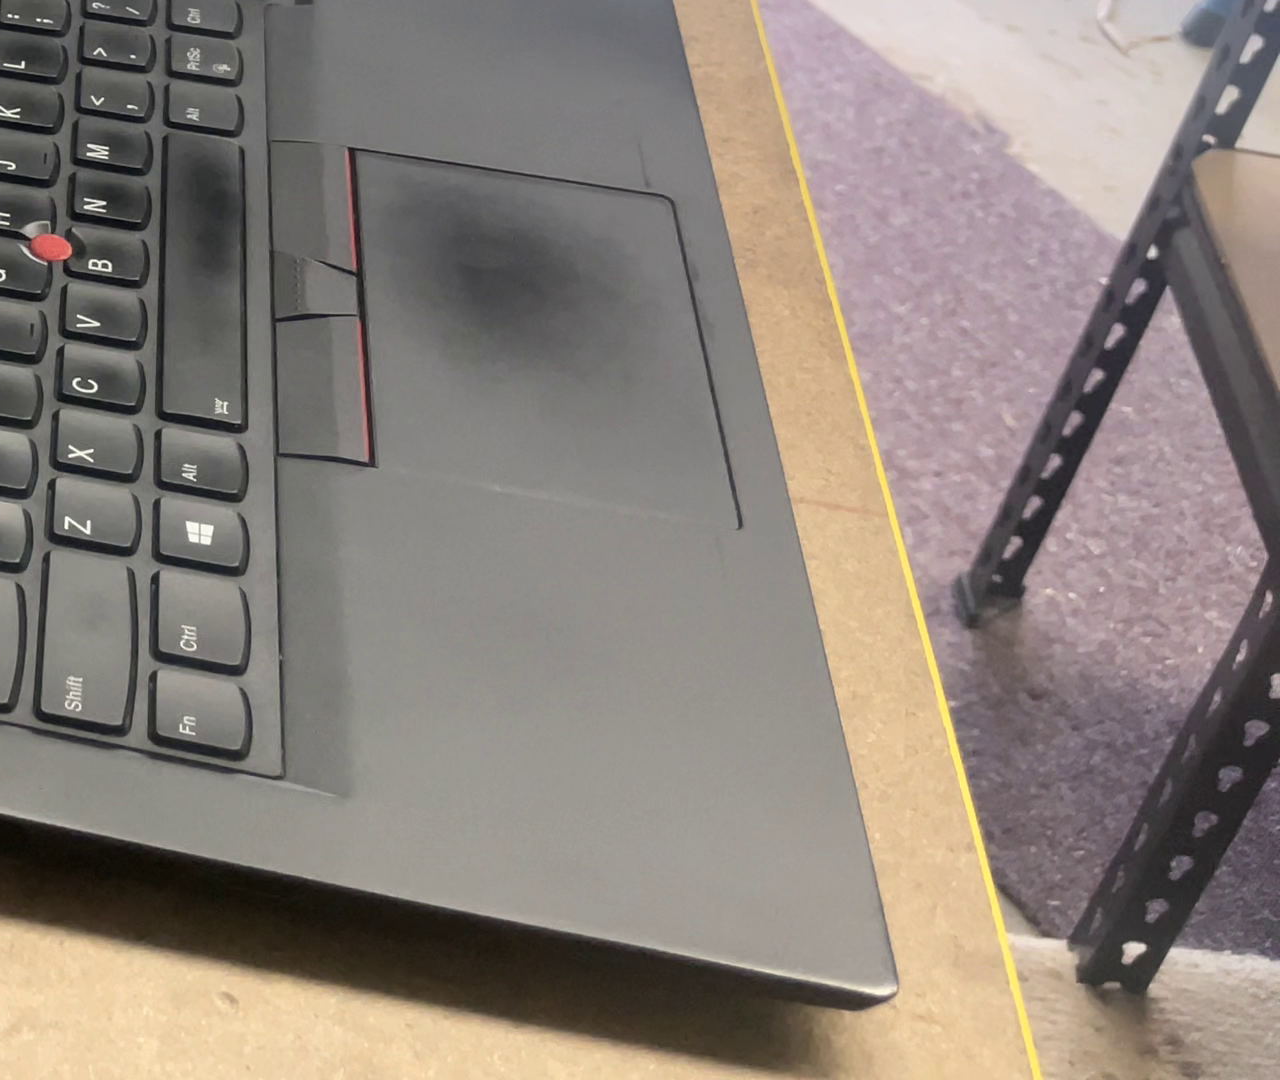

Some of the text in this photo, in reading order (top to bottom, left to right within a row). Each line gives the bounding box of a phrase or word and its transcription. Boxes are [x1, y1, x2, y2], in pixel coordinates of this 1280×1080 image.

[3, 60, 26, 69] L
[187, 48, 201, 72] PrtSc
[188, 108, 200, 121] Alt
[86, 144, 110, 159] M
[83, 198, 107, 212] N
[88, 259, 112, 272] B
[76, 315, 102, 328] V
[72, 377, 99, 393] C
[68, 445, 94, 462] X
[181, 463, 198, 482] Alt
[64, 516, 91, 534] Z
[180, 625, 199, 652] Ctrl
[65, 676, 83, 712] Shift
[179, 716, 197, 736] Fn
